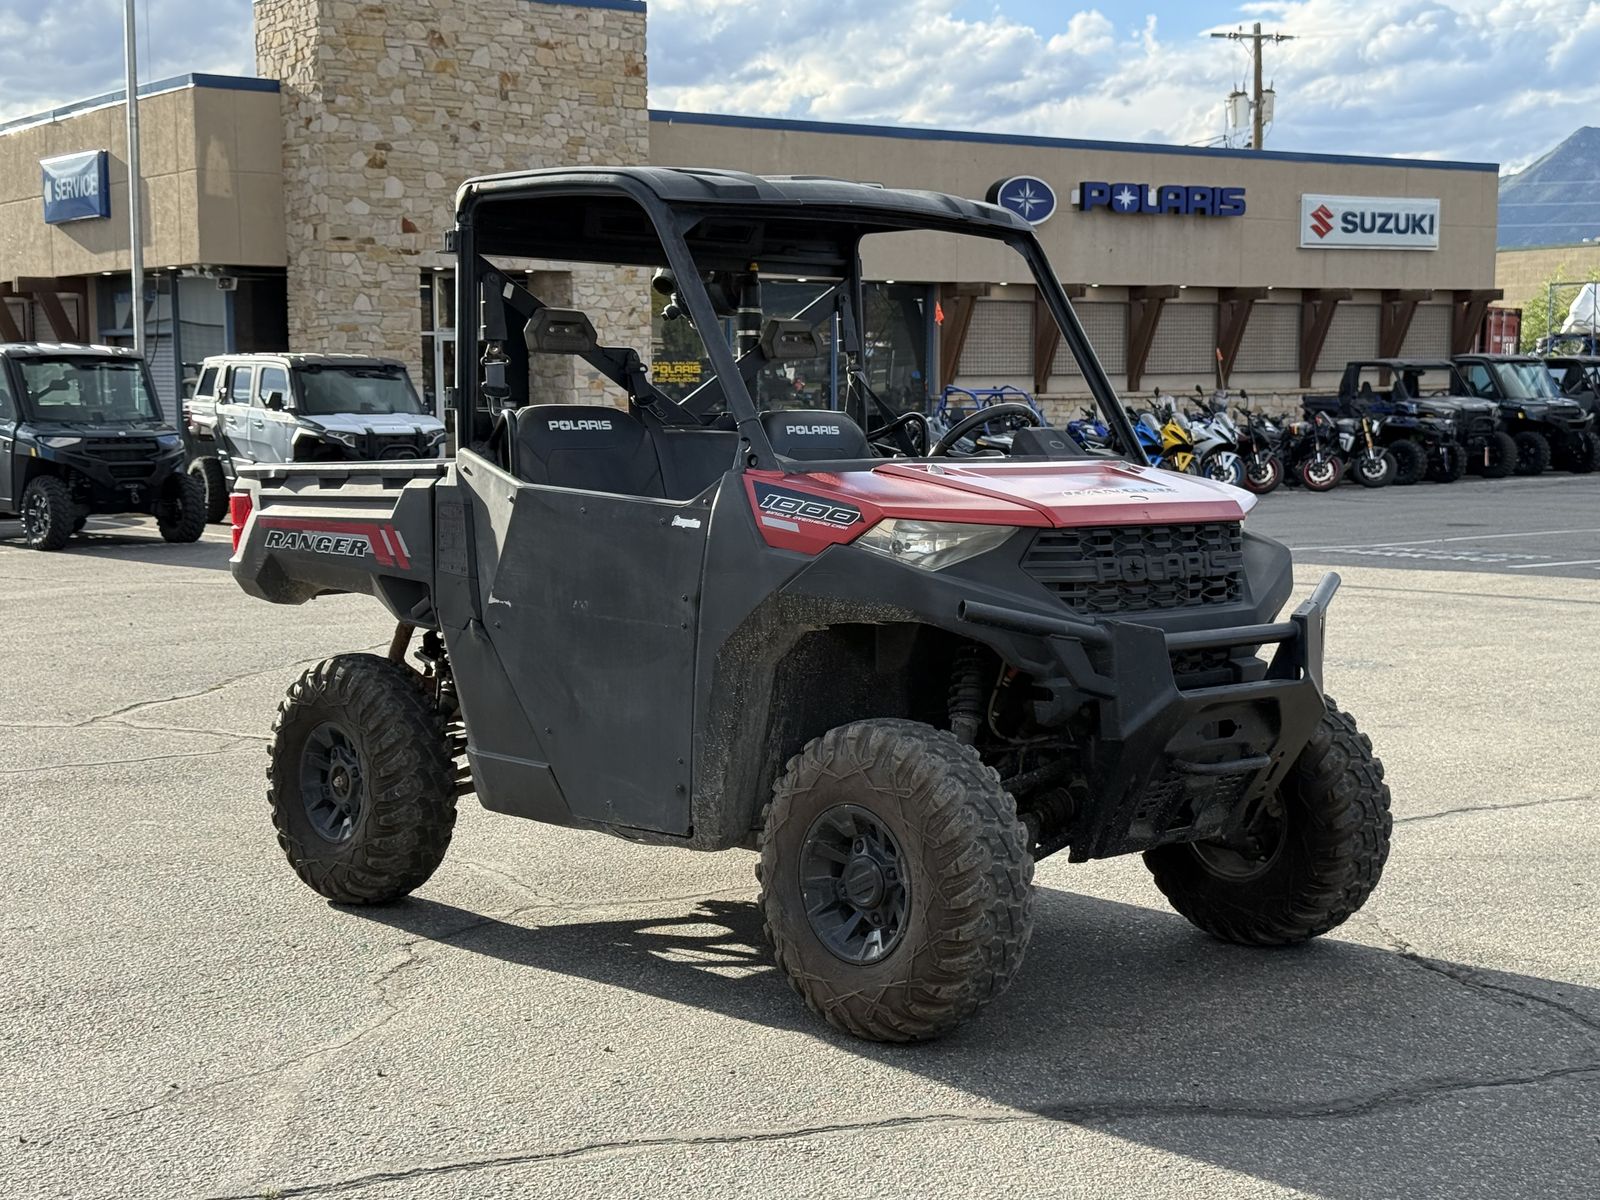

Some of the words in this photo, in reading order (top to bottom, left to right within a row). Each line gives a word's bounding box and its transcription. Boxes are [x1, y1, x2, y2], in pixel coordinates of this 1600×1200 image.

[54, 173, 99, 201] SERVICE
[1080, 181, 1246, 216] POLARIS
[1340, 210, 1435, 235] SUZUKI
[651, 365, 702, 374] POLARIS
[547, 420, 613, 431] POLARIS
[785, 425, 840, 435] POLARIS
[759, 493, 861, 526] 1000
[264, 530, 370, 557] RANGER
[1096, 550, 1243, 584] POLARIS
